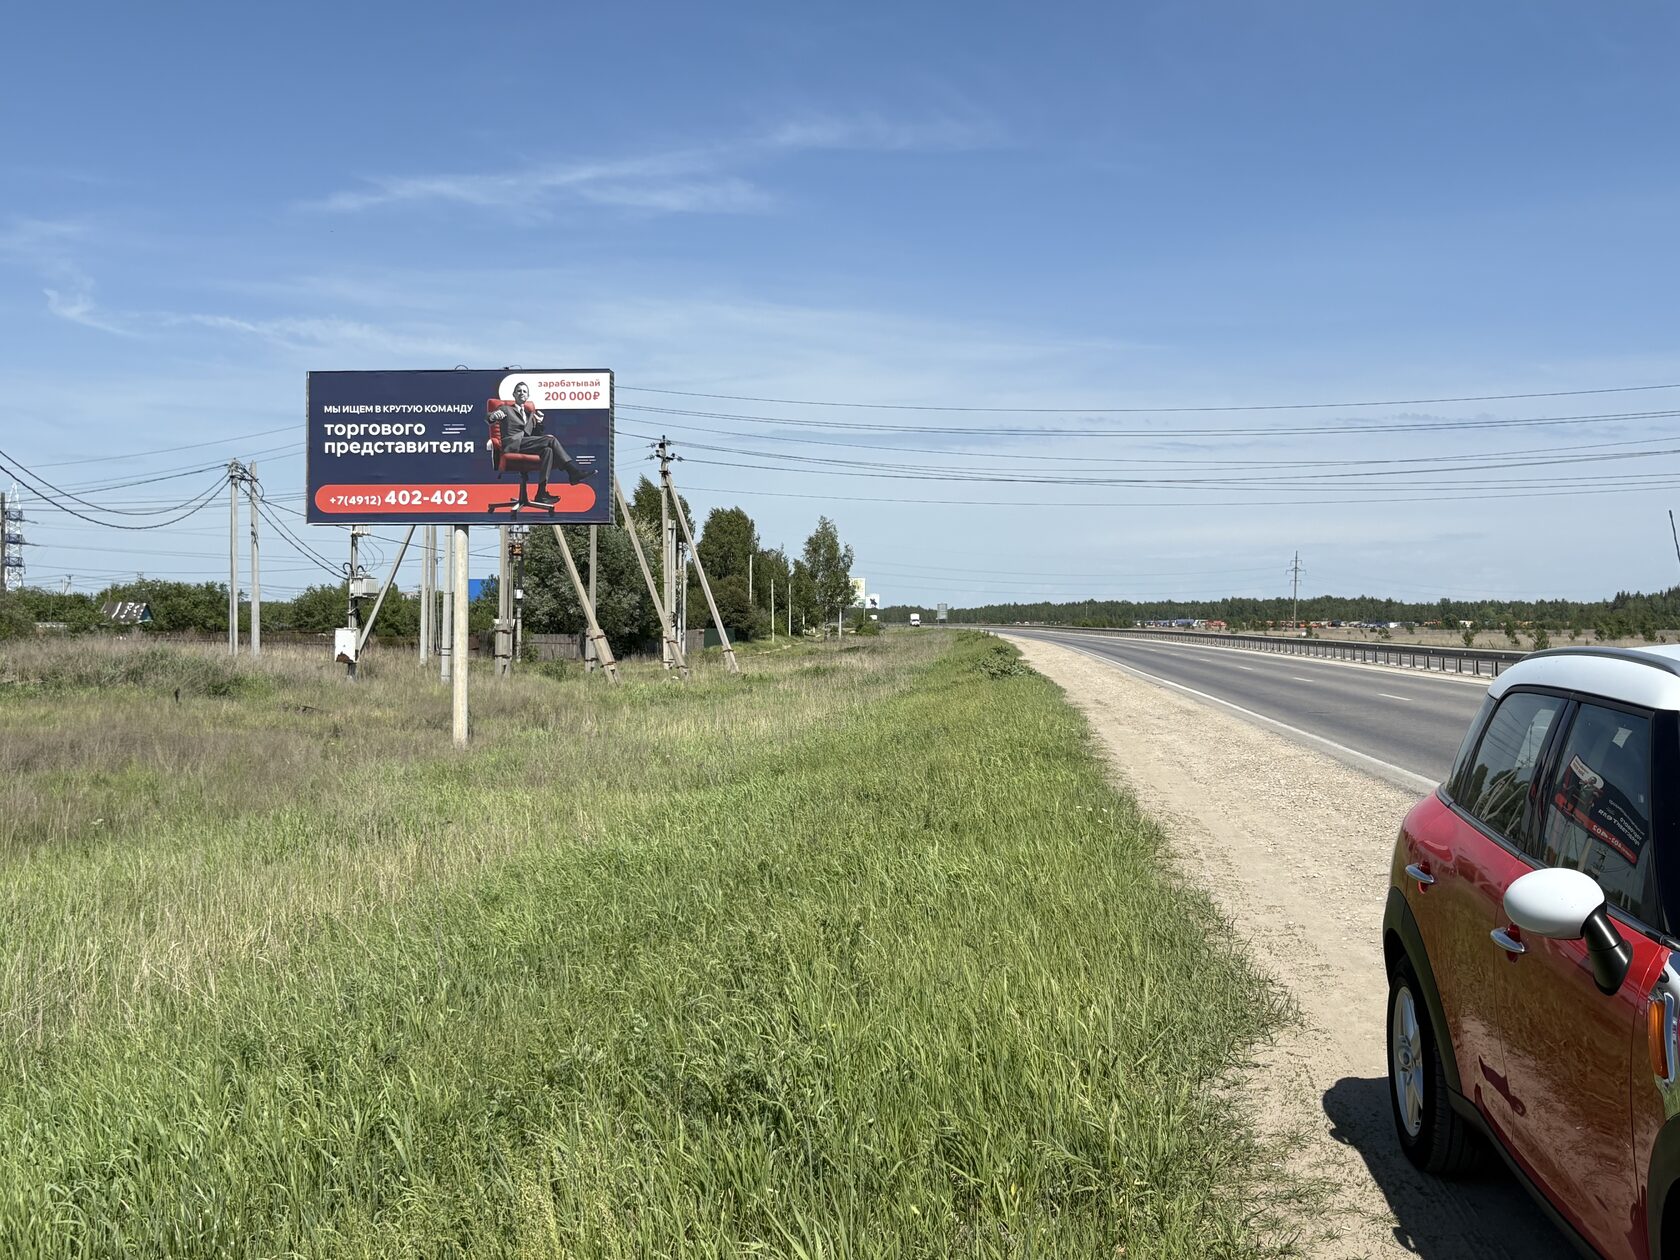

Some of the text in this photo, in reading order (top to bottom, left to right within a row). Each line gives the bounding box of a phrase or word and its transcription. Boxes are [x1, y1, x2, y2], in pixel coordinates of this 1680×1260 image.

[538, 379, 600, 389] зарабатывай
[544, 391, 600, 401] 200 000₽
[324, 404, 474, 415] МЫ ИЩЕМ В КРУТУЮ КОМАНДУ
[324, 423, 426, 440] торгового
[324, 441, 475, 458] представителя
[329, 490, 468, 506] +7(4912) 402-402
